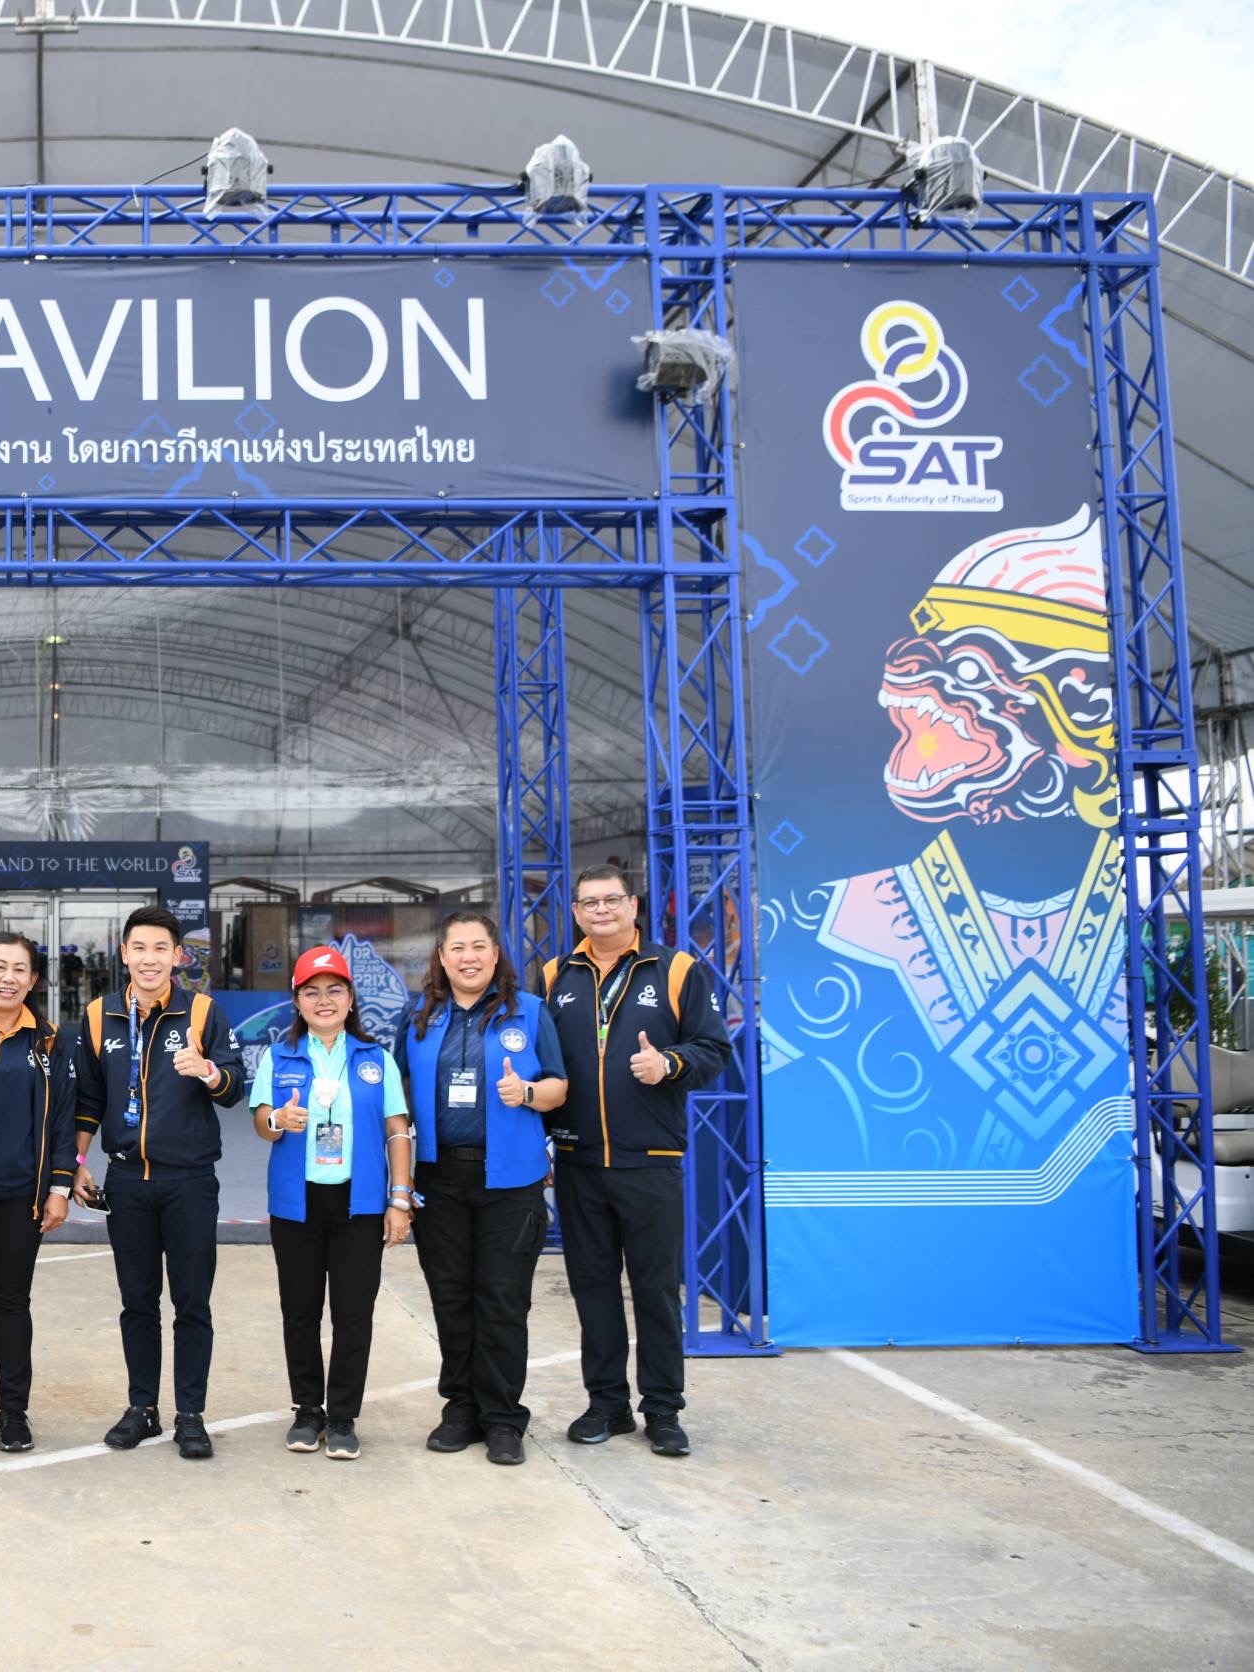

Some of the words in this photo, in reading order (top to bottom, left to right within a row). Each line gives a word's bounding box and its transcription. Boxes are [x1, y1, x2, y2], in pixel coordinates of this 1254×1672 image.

[62, 425, 476, 464] โดยการกีฬาแห่งประเทศไทย
[848, 441, 997, 486] SAT
[847, 494, 883, 505] Sports
[885, 494, 934, 506] Authority
[937, 494, 949, 504] of
[951, 494, 997, 505] Thailand
[64, 857, 100, 872] THE
[104, 857, 169, 872] WORLD
[353, 947, 371, 959] OR
[353, 965, 386, 974] GRAND
[353, 974, 386, 987] PRIX
